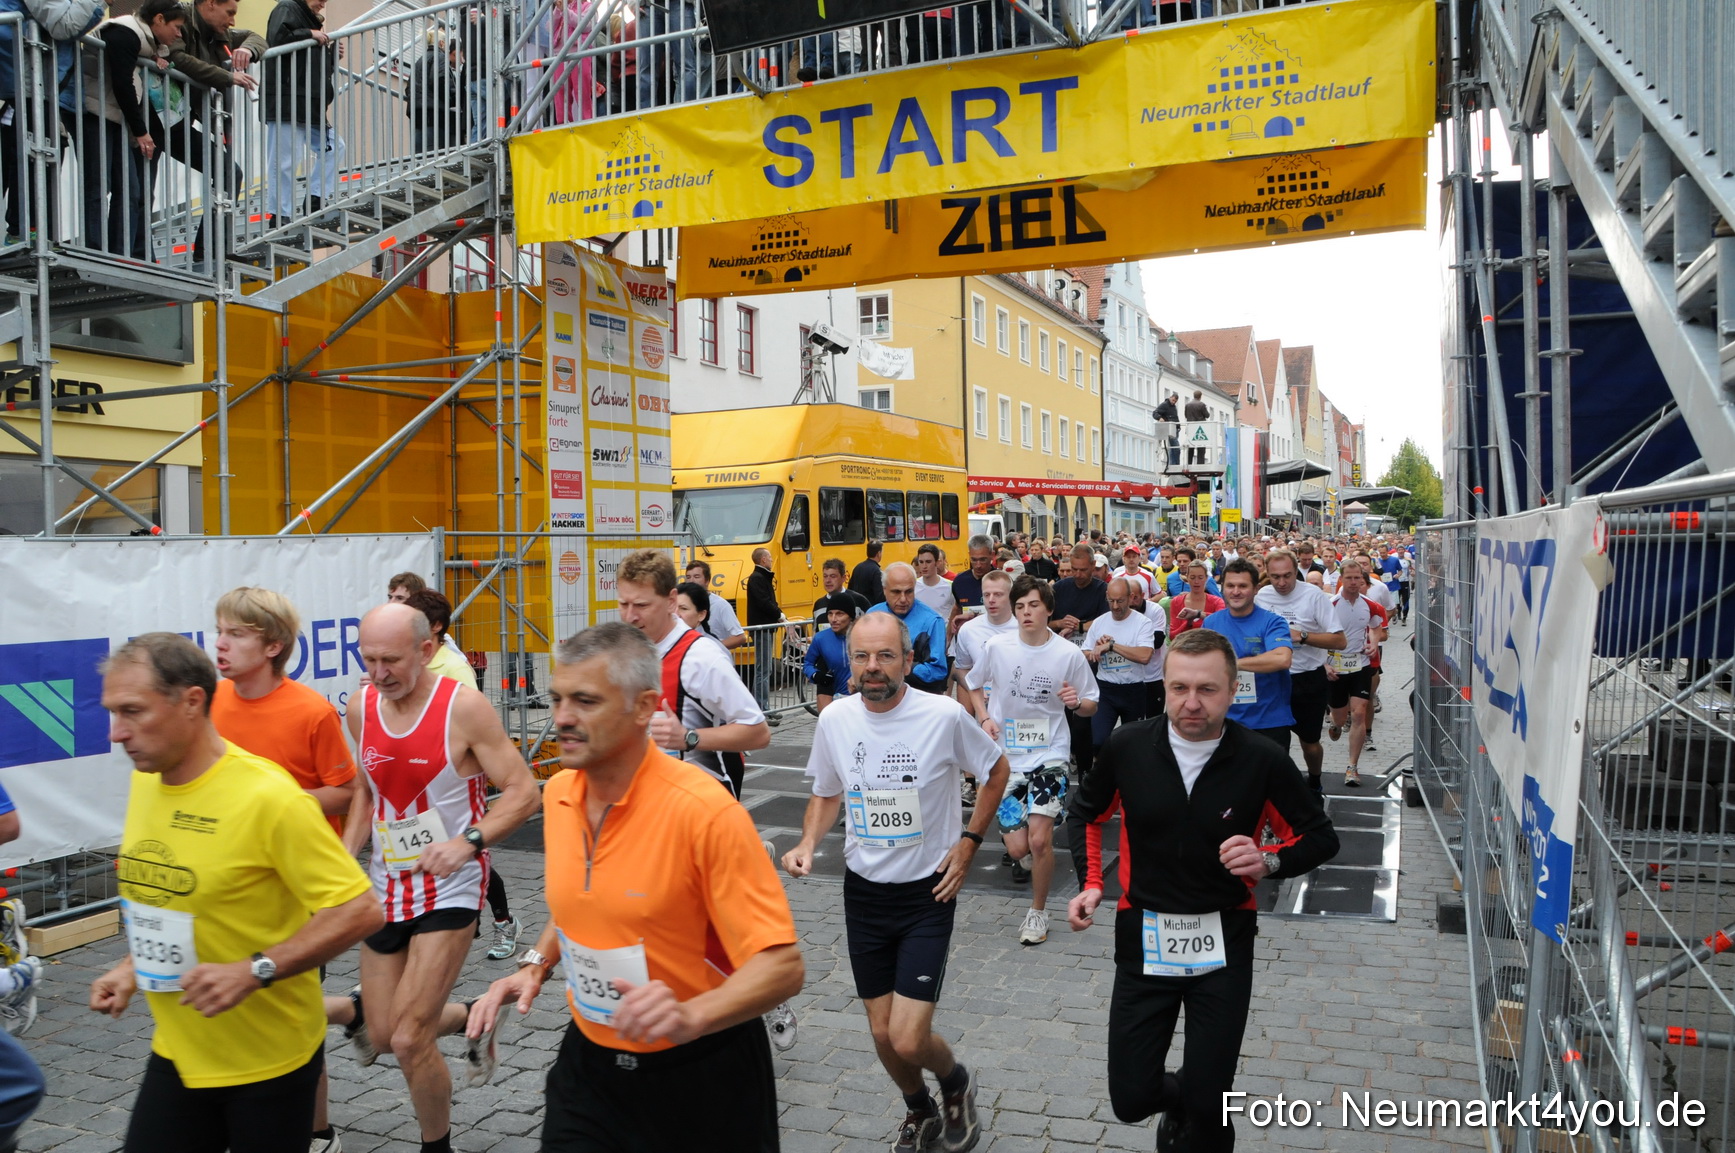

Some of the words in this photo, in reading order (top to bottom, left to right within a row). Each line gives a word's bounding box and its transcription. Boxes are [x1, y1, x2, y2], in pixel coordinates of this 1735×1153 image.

[1140, 92, 1265, 125] Neumarkter
[1270, 76, 1373, 107] Stadtlauf
[762, 76, 1079, 189] START
[546, 180, 634, 206] Neumarkter
[638, 169, 716, 193] Stadtlauf
[1203, 195, 1301, 219] Neumarkter
[1303, 182, 1386, 207] Stadtlauf
[938, 185, 1107, 257] ZIEL
[707, 250, 787, 270] Neumarkter
[789, 243, 853, 261] Stadtlauf
[626, 281, 668, 301] MERZ
[548, 400, 581, 416] Sinupret
[638, 394, 670, 413] OBI
[548, 414, 569, 428] forte
[705, 471, 760, 483] TIMING
[840, 464, 871, 475] SPORTRONIC
[915, 472, 929, 482] EVENT
[551, 519, 585, 529] HACKNER
[1343, 660, 1358, 668] 402
[1018, 732, 1045, 742] 2174
[880, 765, 918, 773] 21.09.2008
[866, 795, 897, 807] Helmut
[870, 811, 913, 828] 2089
[398, 829, 434, 852] 143
[1163, 916, 1202, 931] Michael
[1166, 934, 1216, 954] 2709
